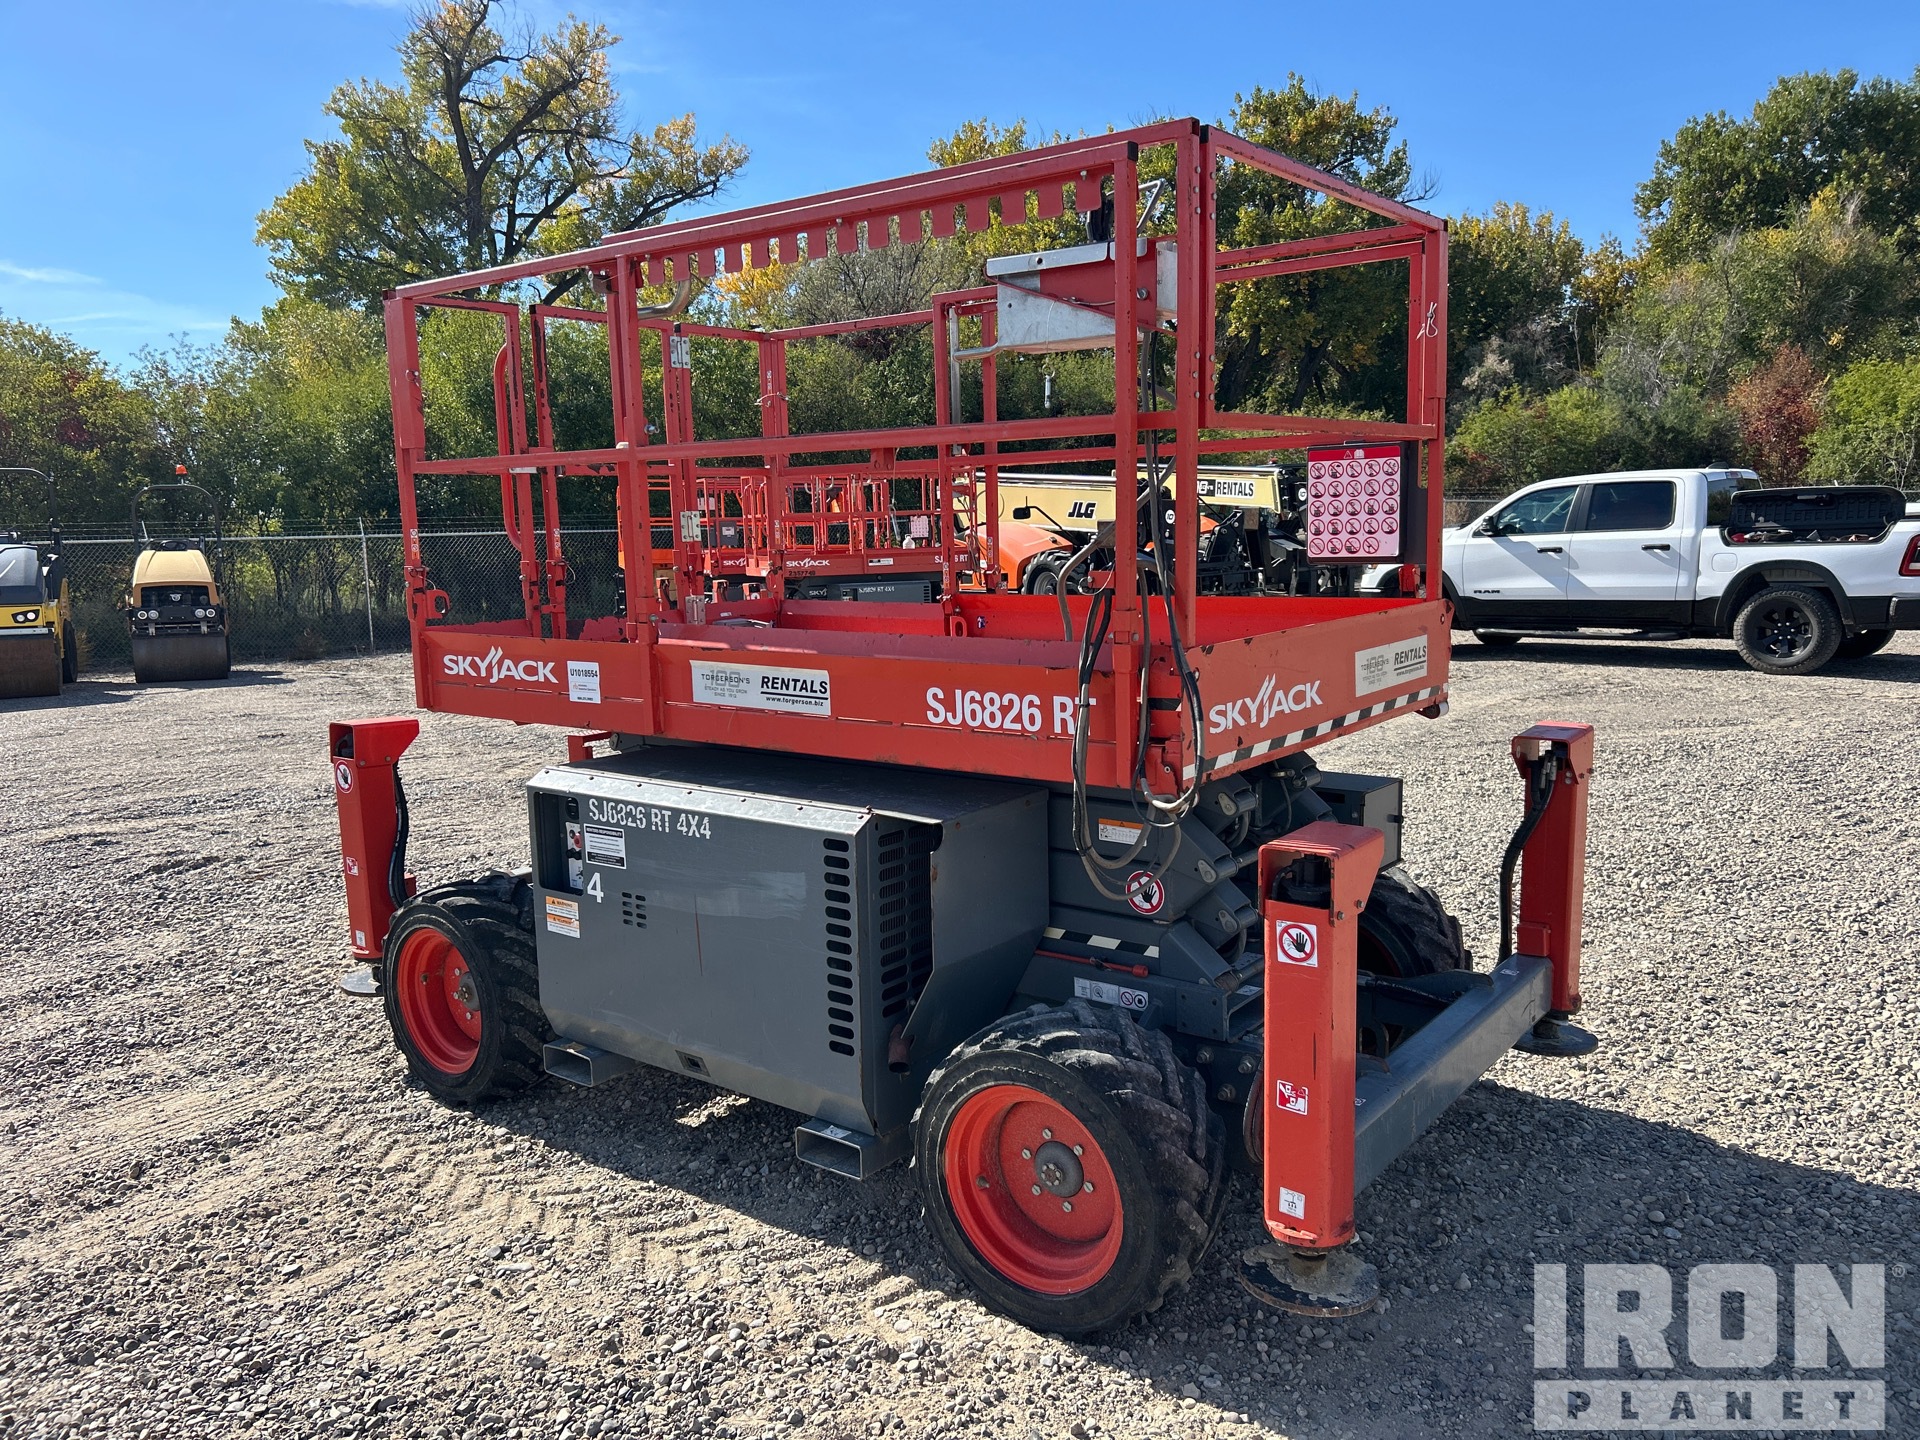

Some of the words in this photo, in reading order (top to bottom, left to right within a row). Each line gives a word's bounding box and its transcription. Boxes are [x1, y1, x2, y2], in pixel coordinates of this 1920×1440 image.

[1216, 481, 1254, 497] RENTALS
[1067, 501, 1097, 518] JLG
[786, 558, 830, 568] SKYJACK
[443, 646, 559, 684] SKYJACK
[1394, 645, 1427, 666] RENTALS
[701, 673, 751, 684] TORGERSON'S
[760, 675, 828, 695] RENTALS
[765, 696, 824, 707] www.torgerson.biz
[926, 686, 1042, 732] SJ6826
[1209, 673, 1323, 734] SKYJACK
[588, 798, 646, 829] SJ6826
[650, 808, 672, 833] RT
[676, 813, 712, 839] 4X4
[587, 872, 604, 903] 4
